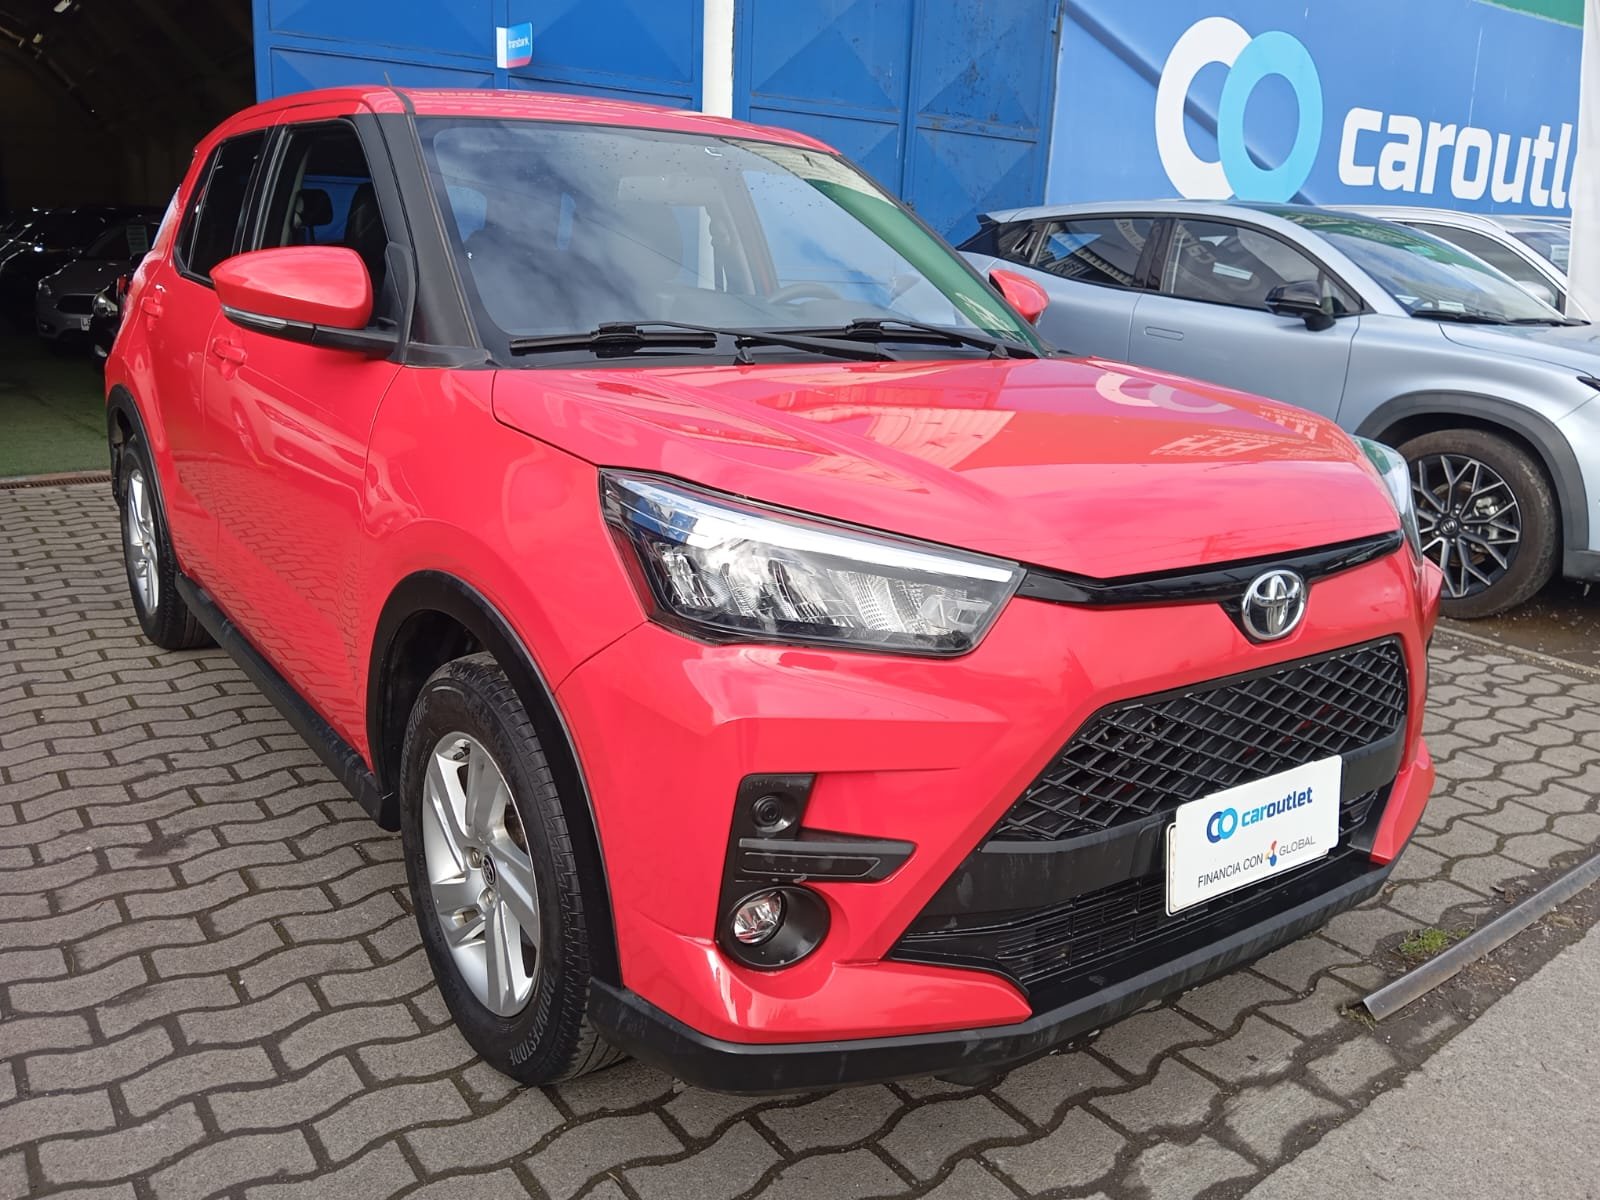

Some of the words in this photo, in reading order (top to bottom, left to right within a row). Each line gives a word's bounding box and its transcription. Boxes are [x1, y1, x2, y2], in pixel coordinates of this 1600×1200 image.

[1338, 106, 1578, 209] caroutl
[1241, 786, 1313, 827] caroutlet
[1197, 861, 1241, 888] FINANCIA
[1243, 853, 1264, 871] CON
[1278, 835, 1316, 857] GLOBAL
